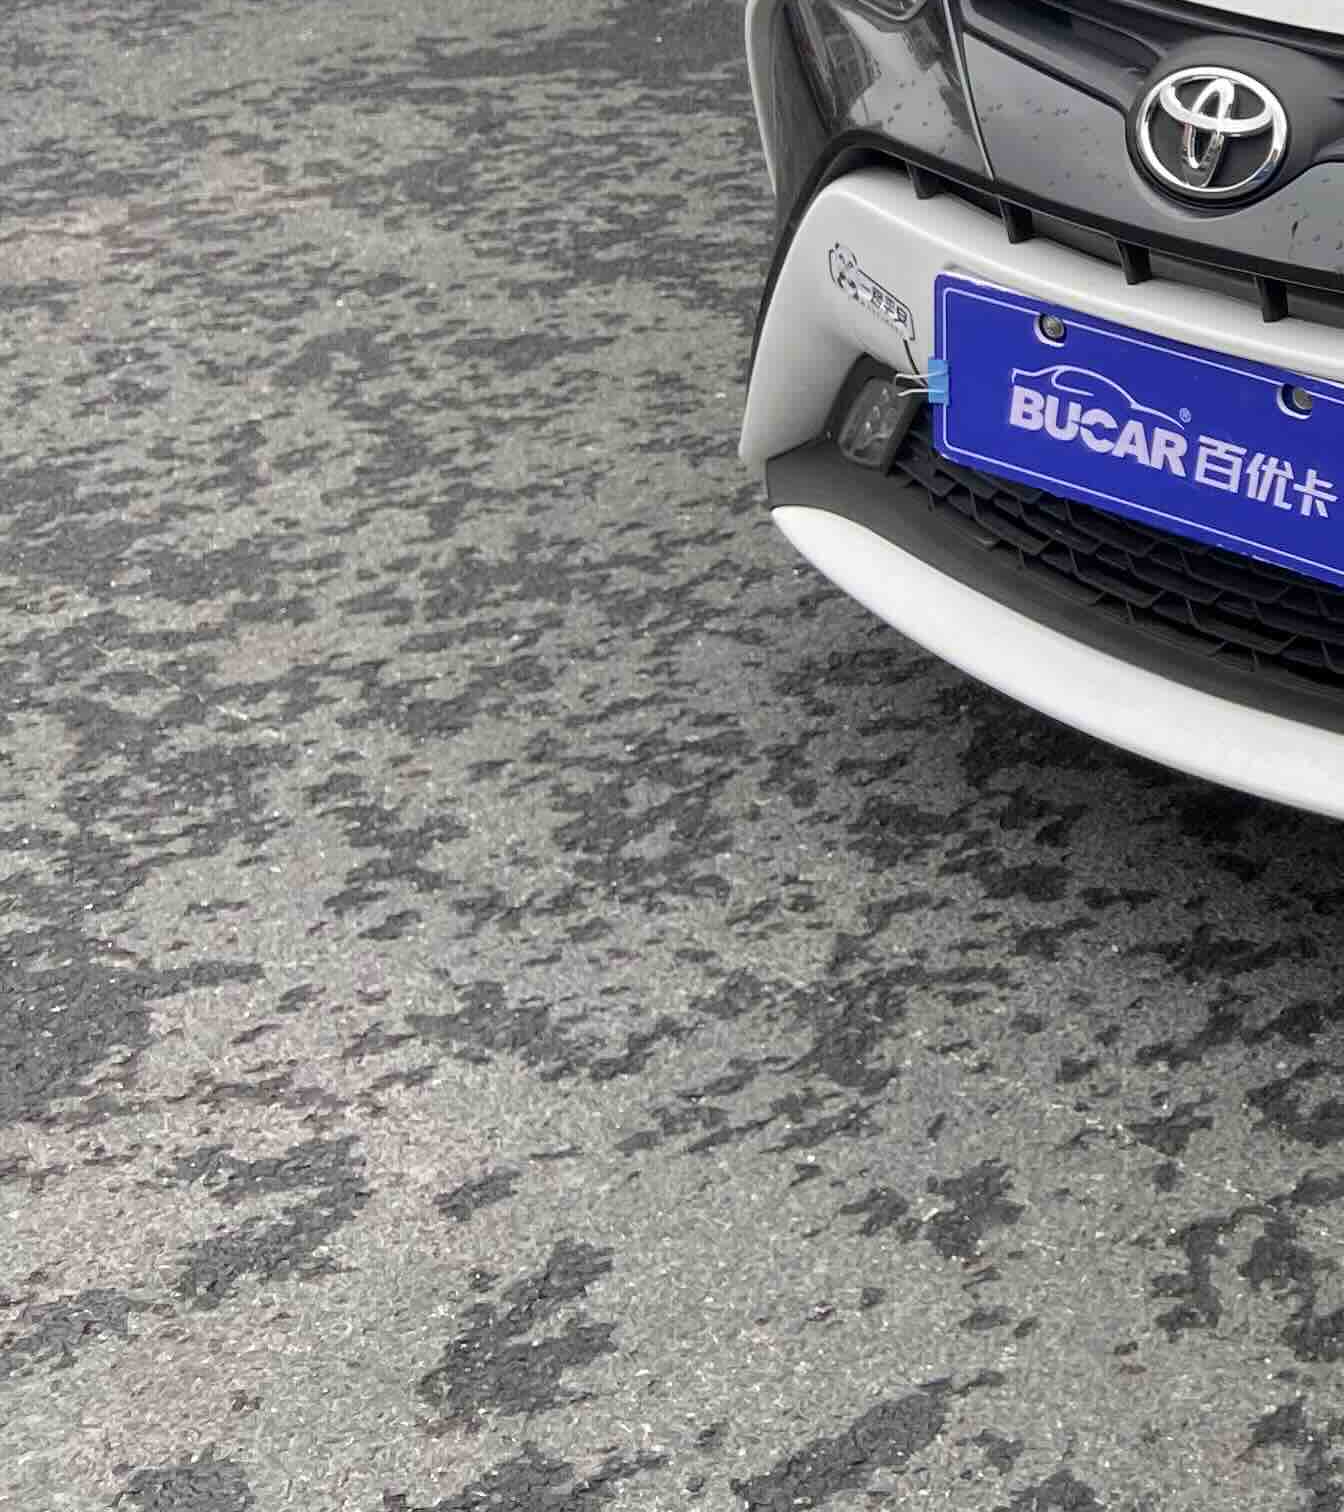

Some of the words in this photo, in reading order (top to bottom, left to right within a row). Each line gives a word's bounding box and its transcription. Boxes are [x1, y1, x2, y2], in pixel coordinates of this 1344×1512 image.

[1010, 386, 1187, 477] BUCAR
[1195, 434, 1339, 518] 百优卡
